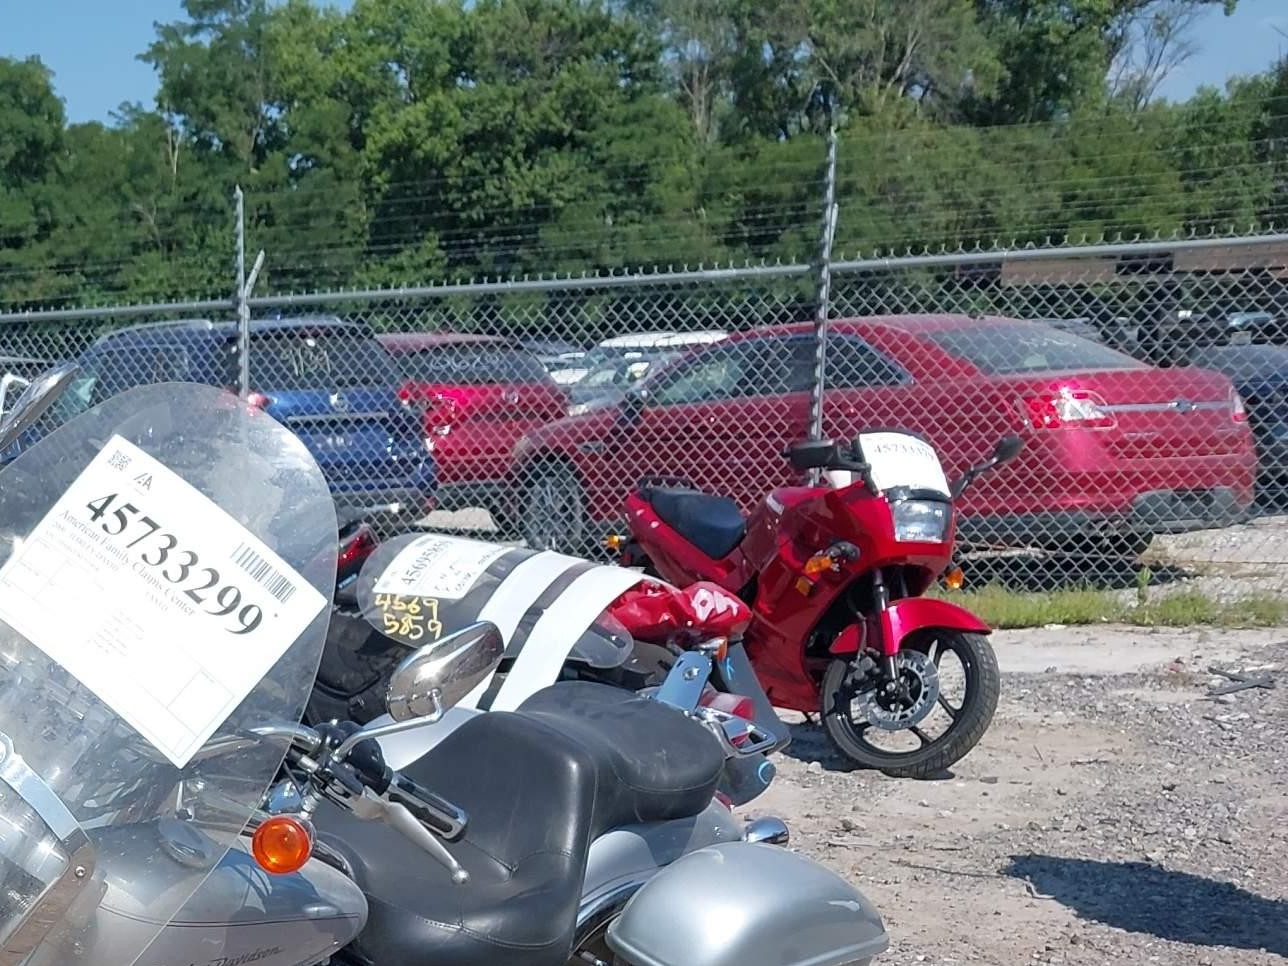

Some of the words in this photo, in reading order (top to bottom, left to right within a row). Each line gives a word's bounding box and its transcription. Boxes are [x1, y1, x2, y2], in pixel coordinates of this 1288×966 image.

[59, 510, 100, 542] American
[85, 493, 263, 635] 45733299
[375, 594, 439, 622] 4569
